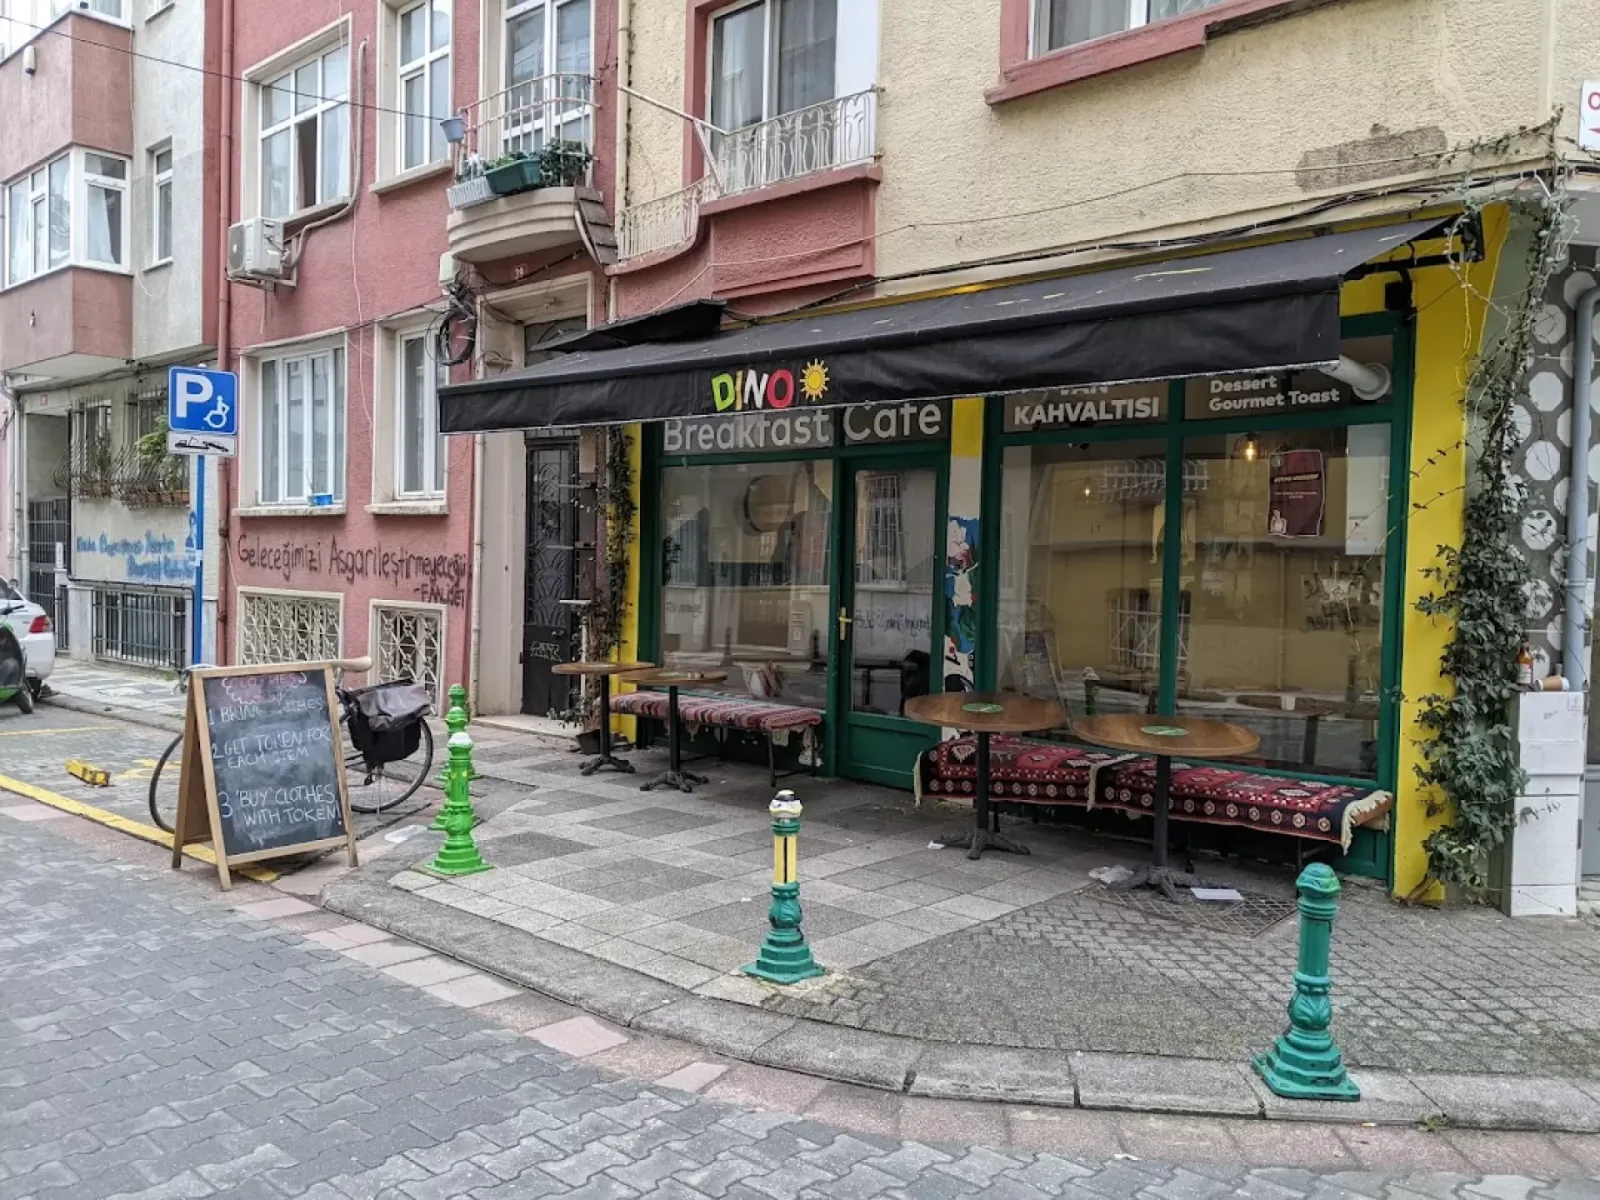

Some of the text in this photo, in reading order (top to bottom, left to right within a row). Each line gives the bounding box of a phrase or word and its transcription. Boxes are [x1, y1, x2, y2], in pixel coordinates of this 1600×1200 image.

[176, 373, 213, 418] P
[711, 368, 794, 411] DINO
[1209, 387, 1340, 411] Gourmet Toast
[1210, 375, 1278, 394] Dessert
[1014, 396, 1160, 425] KAHVALTISI
[663, 402, 942, 451] Breakfast Cafe
[224, 738, 248, 756] GET
[307, 726, 331, 742] FOR
[275, 783, 336, 804] CLOTHES
[242, 807, 281, 827] WITH
